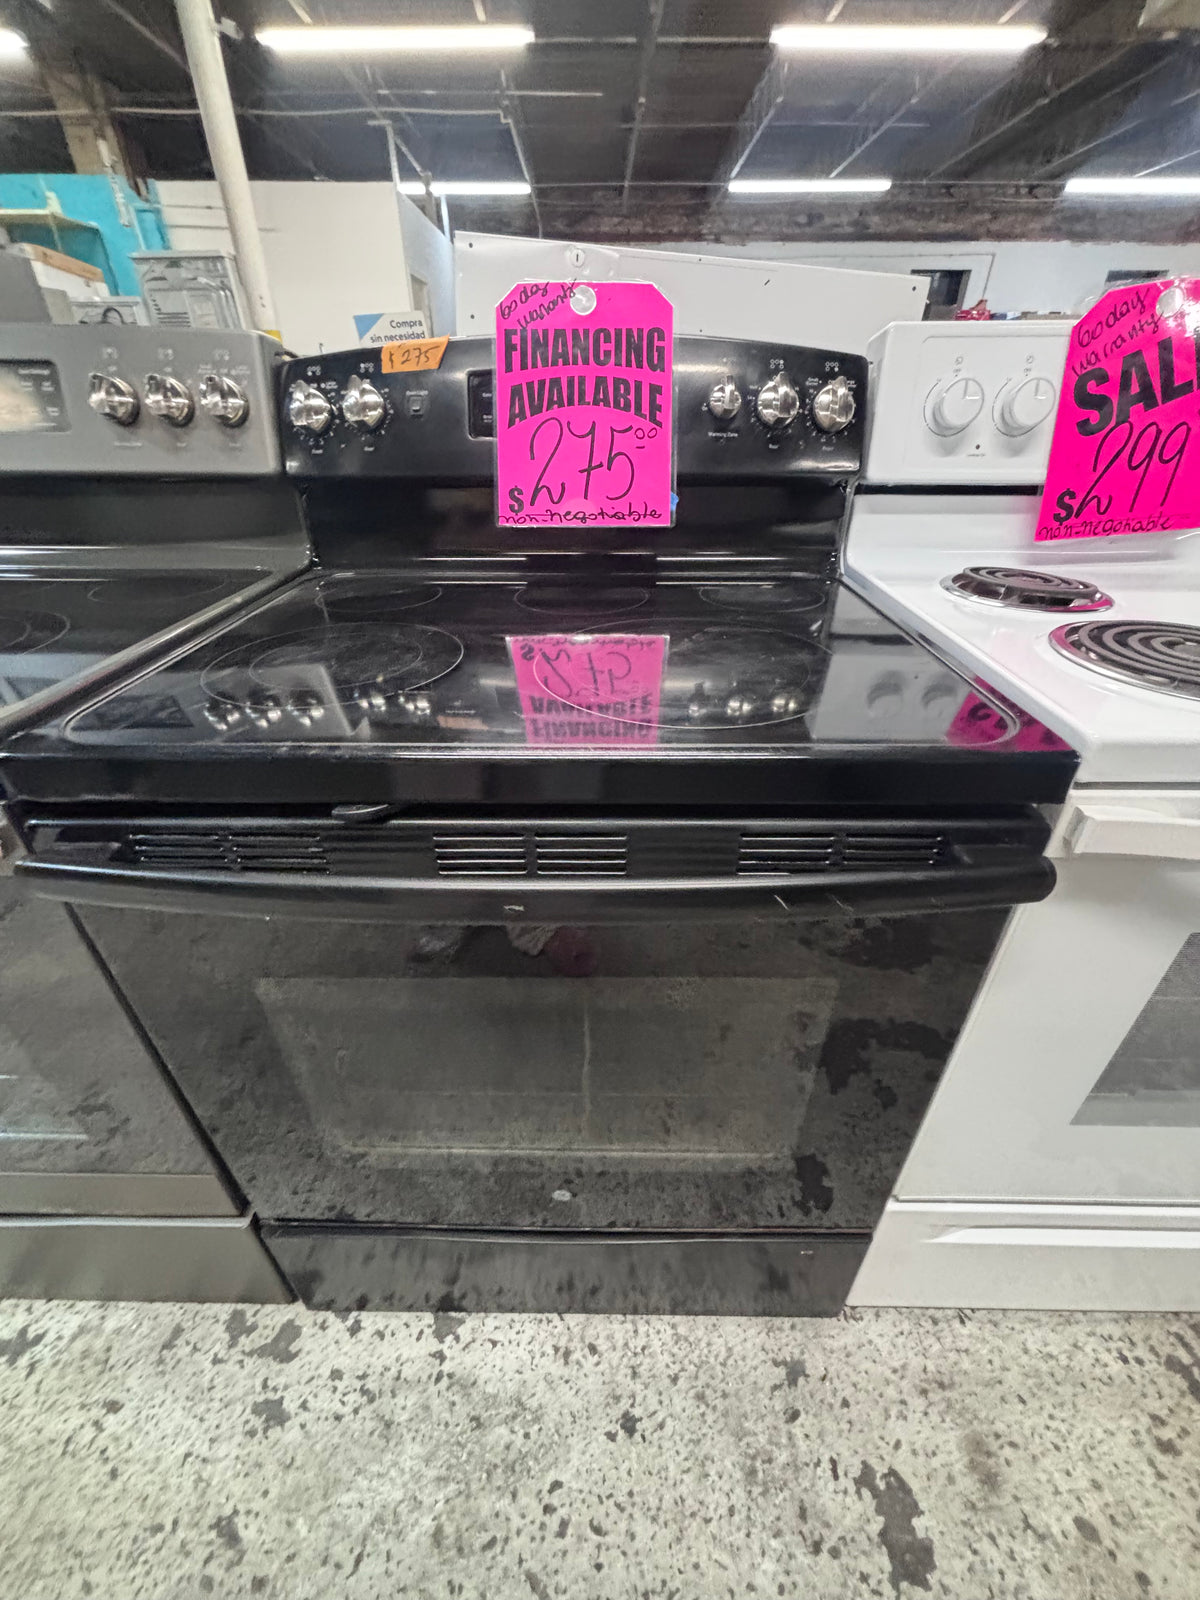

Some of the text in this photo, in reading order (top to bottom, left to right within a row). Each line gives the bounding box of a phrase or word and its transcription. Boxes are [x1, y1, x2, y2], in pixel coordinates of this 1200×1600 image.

[389, 320, 423, 329] Compra
[1105, 288, 1150, 329] day
[370, 331, 426, 343] sin necesidad
[504, 326, 666, 374] FINANCING
[508, 375, 663, 429] AVAILABLE
